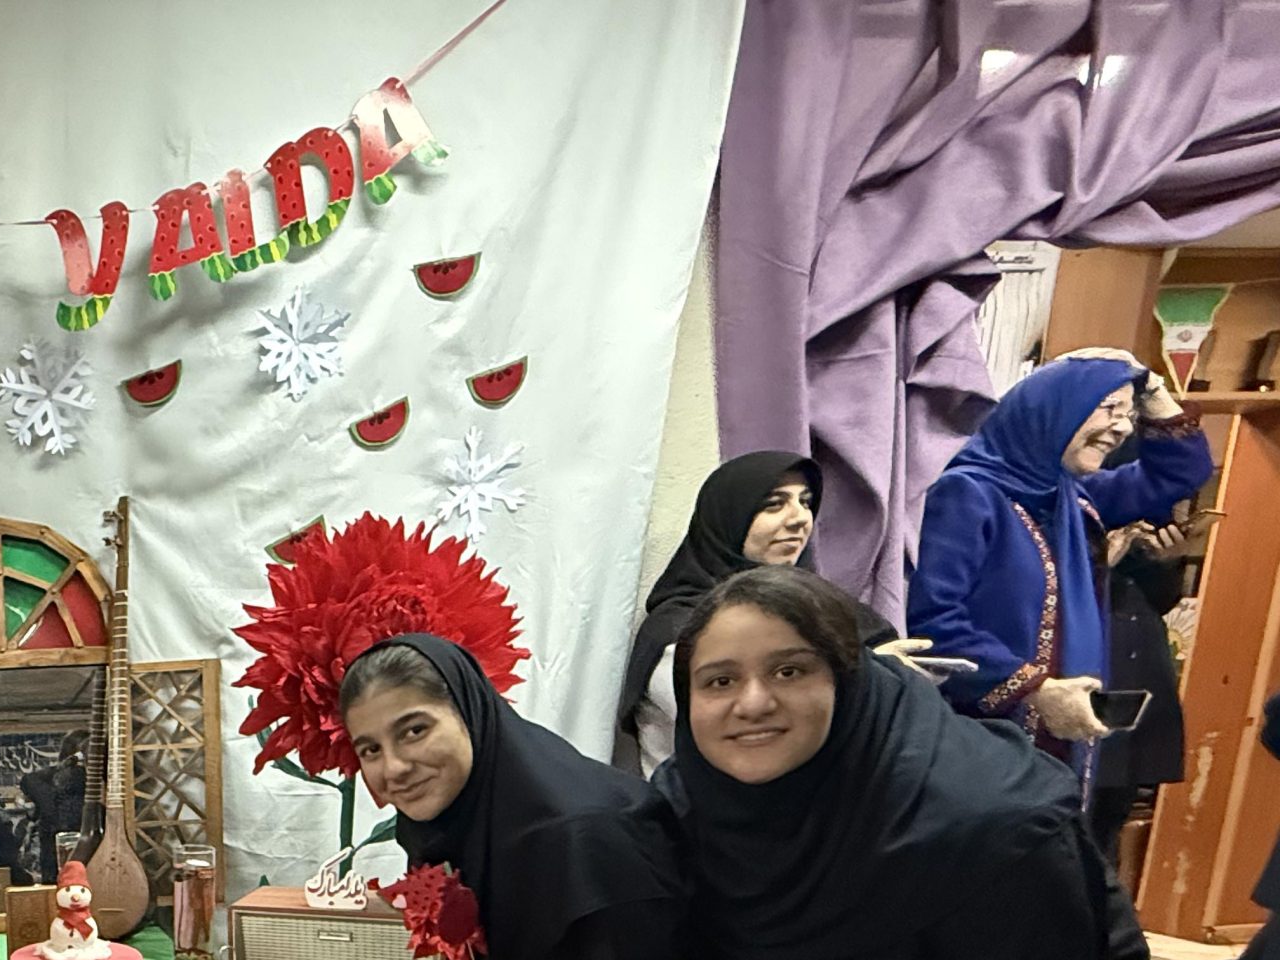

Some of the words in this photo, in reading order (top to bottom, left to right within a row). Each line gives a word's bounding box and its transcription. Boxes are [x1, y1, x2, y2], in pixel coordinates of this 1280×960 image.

[44, 76, 450, 332] YALDA
[307, 852, 347, 906] مبارک
[342, 876, 364, 905] یلدا
